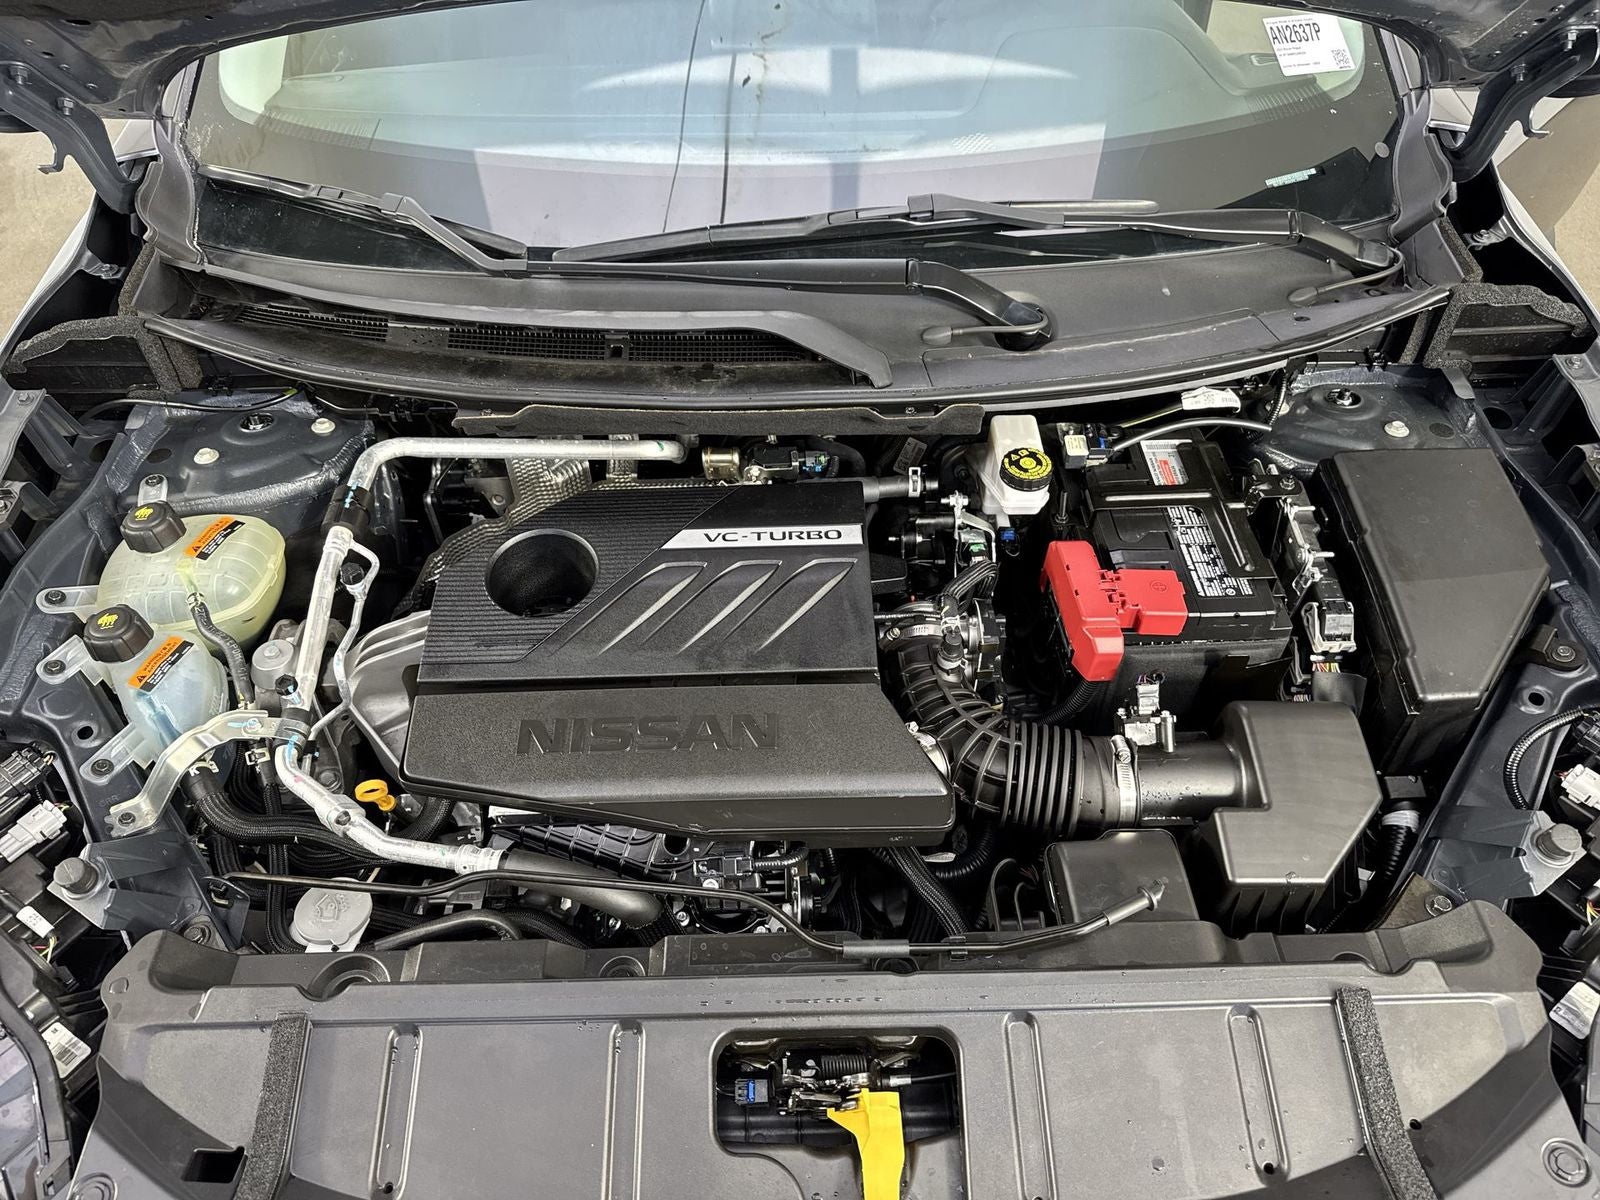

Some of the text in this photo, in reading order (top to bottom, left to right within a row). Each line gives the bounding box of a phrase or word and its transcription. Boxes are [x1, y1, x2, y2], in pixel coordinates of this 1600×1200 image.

[1269, 22, 1321, 45] AN2637P
[703, 528, 843, 544] VC-TURBO
[516, 712, 779, 755] NISSAN
